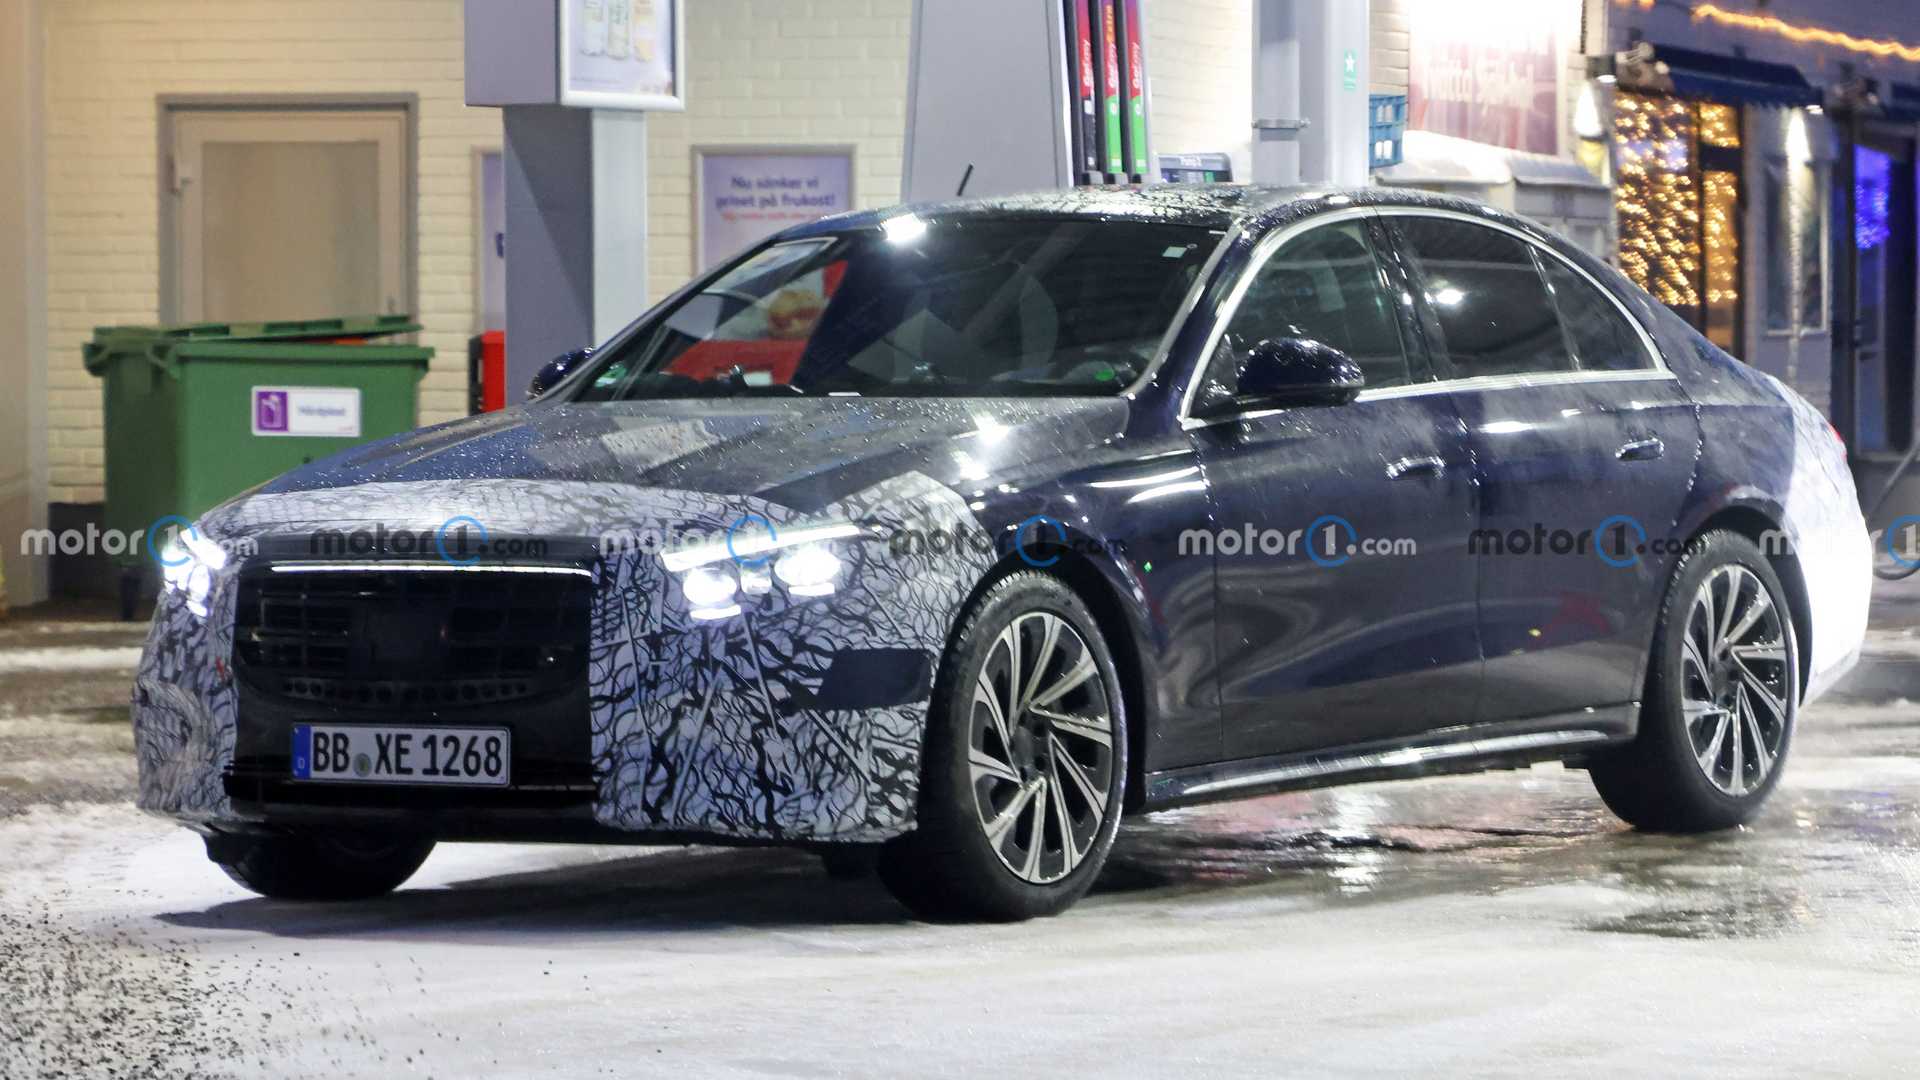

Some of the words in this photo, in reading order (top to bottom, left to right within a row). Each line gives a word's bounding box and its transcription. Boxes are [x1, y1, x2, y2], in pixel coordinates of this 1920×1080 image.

[731, 175, 752, 189] Nu
[806, 176, 819, 189] vi
[759, 193, 779, 209] på
[313, 731, 350, 773] BB
[374, 733, 414, 775] XE
[422, 734, 502, 777] 1268
